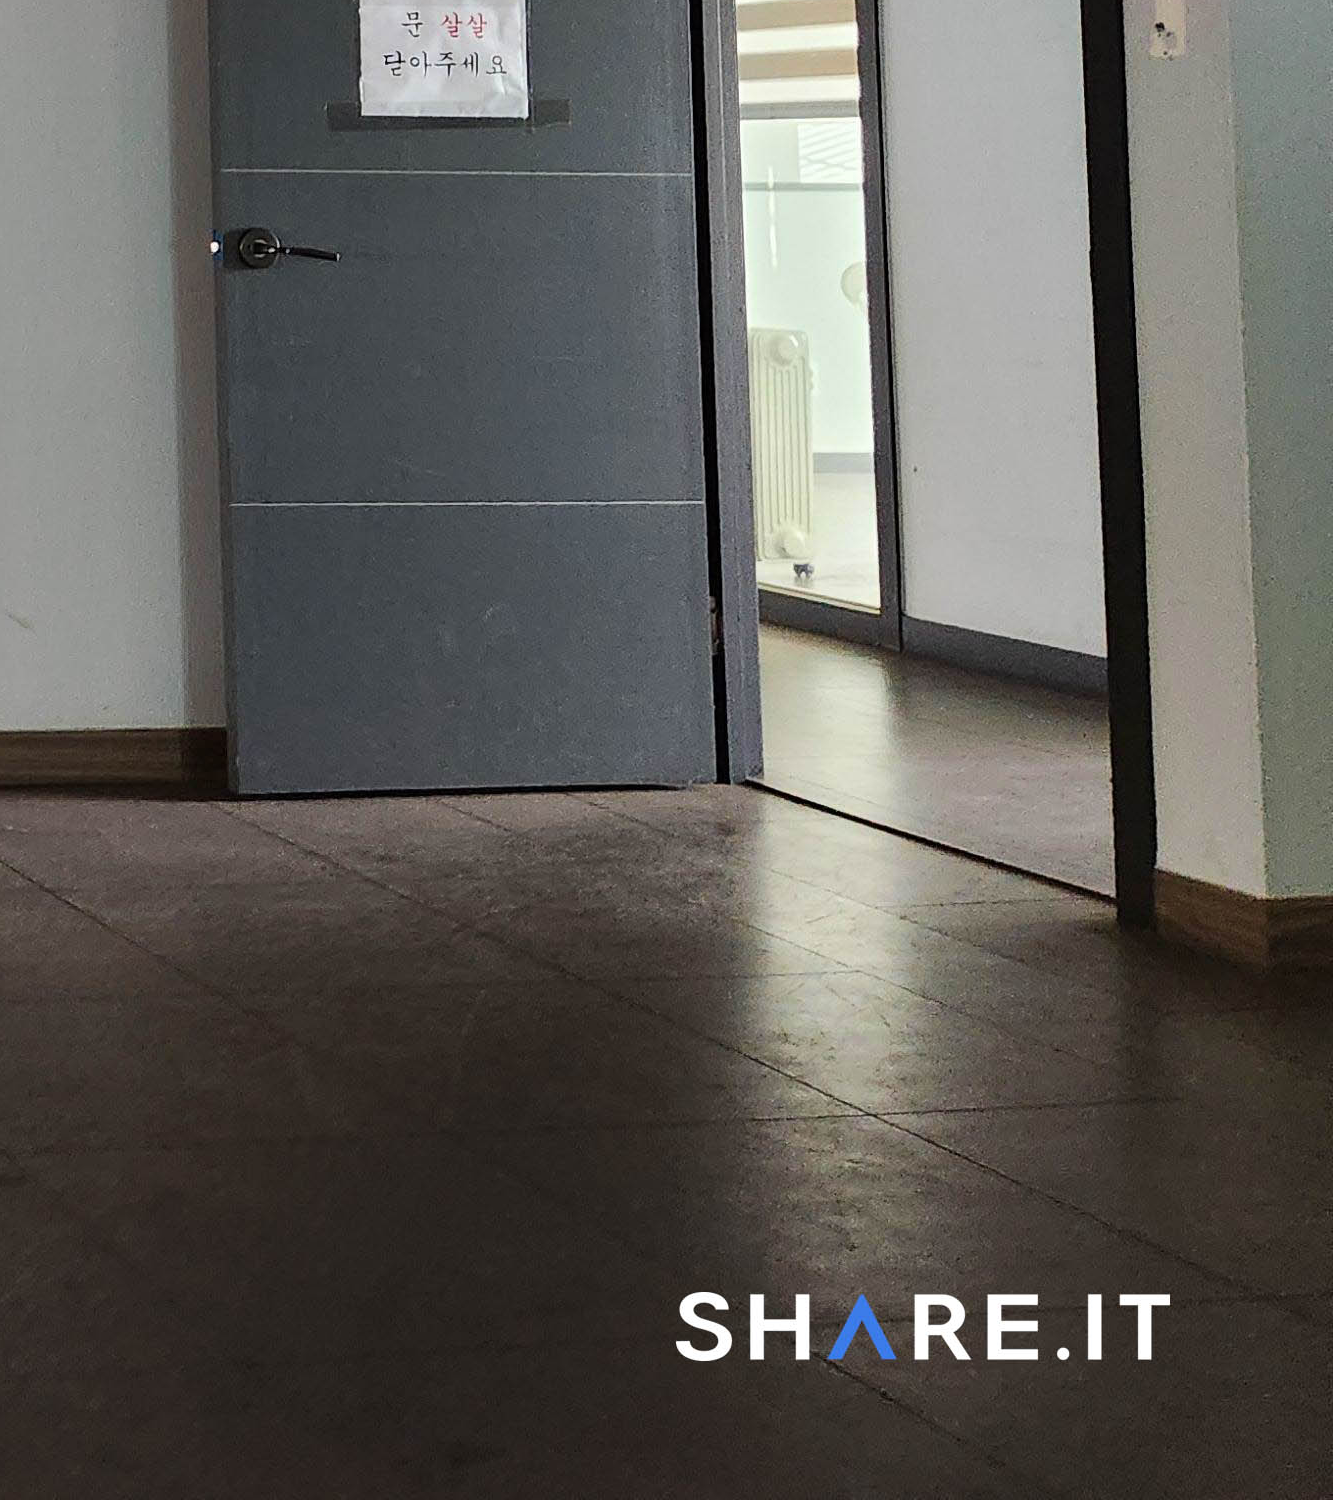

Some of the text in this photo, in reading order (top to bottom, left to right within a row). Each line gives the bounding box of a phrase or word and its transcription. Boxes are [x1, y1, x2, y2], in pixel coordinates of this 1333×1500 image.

[402, 11, 487, 39] 문 살살
[384, 50, 507, 78] 닫아주세요
